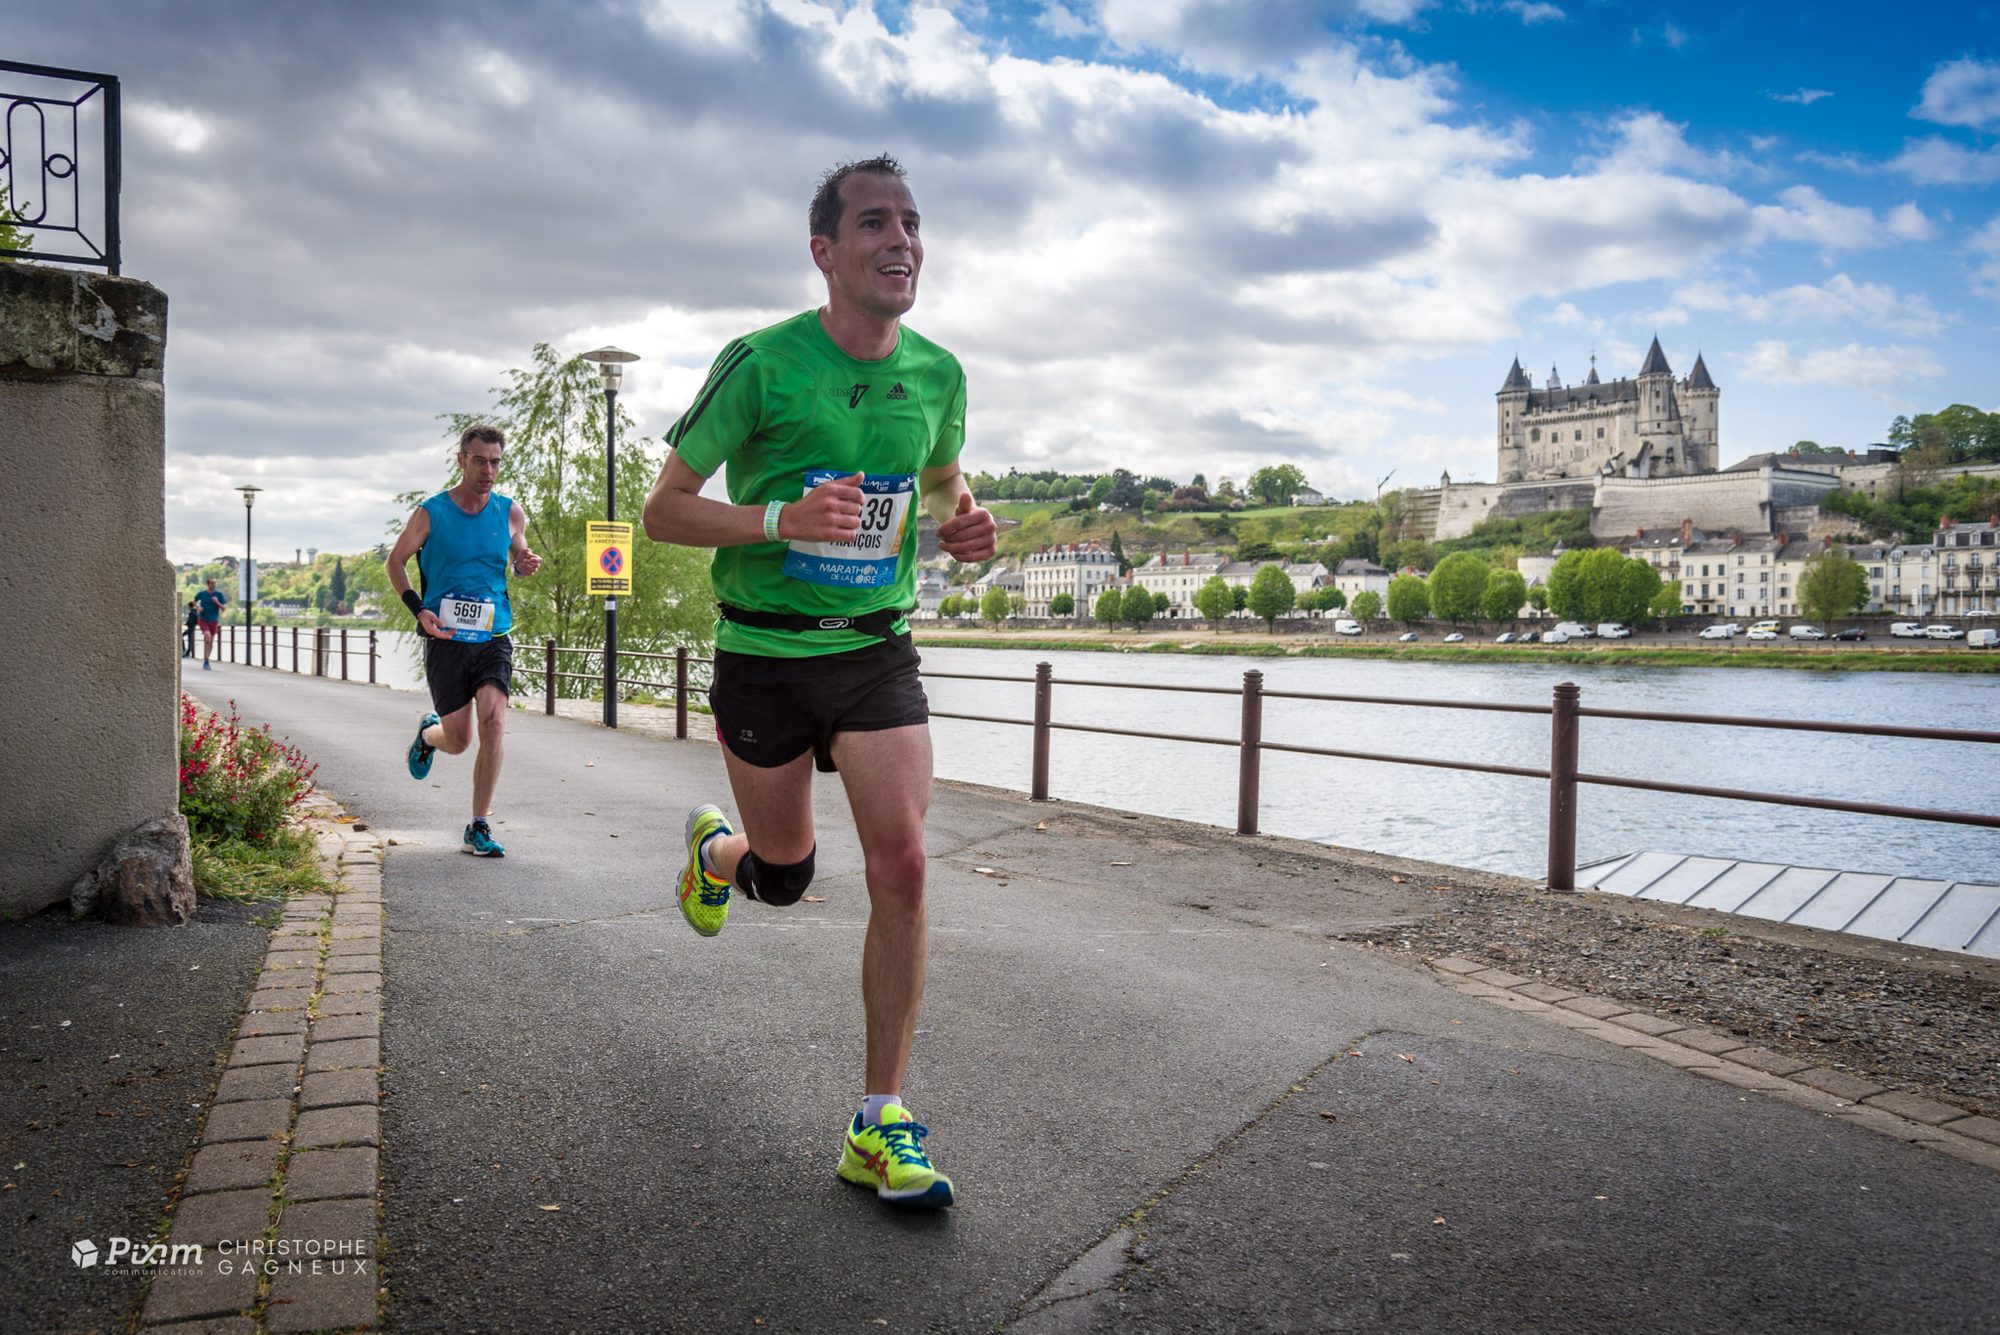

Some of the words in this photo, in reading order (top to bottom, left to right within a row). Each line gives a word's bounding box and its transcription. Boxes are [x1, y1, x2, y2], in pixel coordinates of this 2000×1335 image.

[860, 497, 894, 531] 39
[819, 563, 878, 575] MARATHON
[850, 575, 877, 584] LOIRE
[454, 602, 482, 618] 5691
